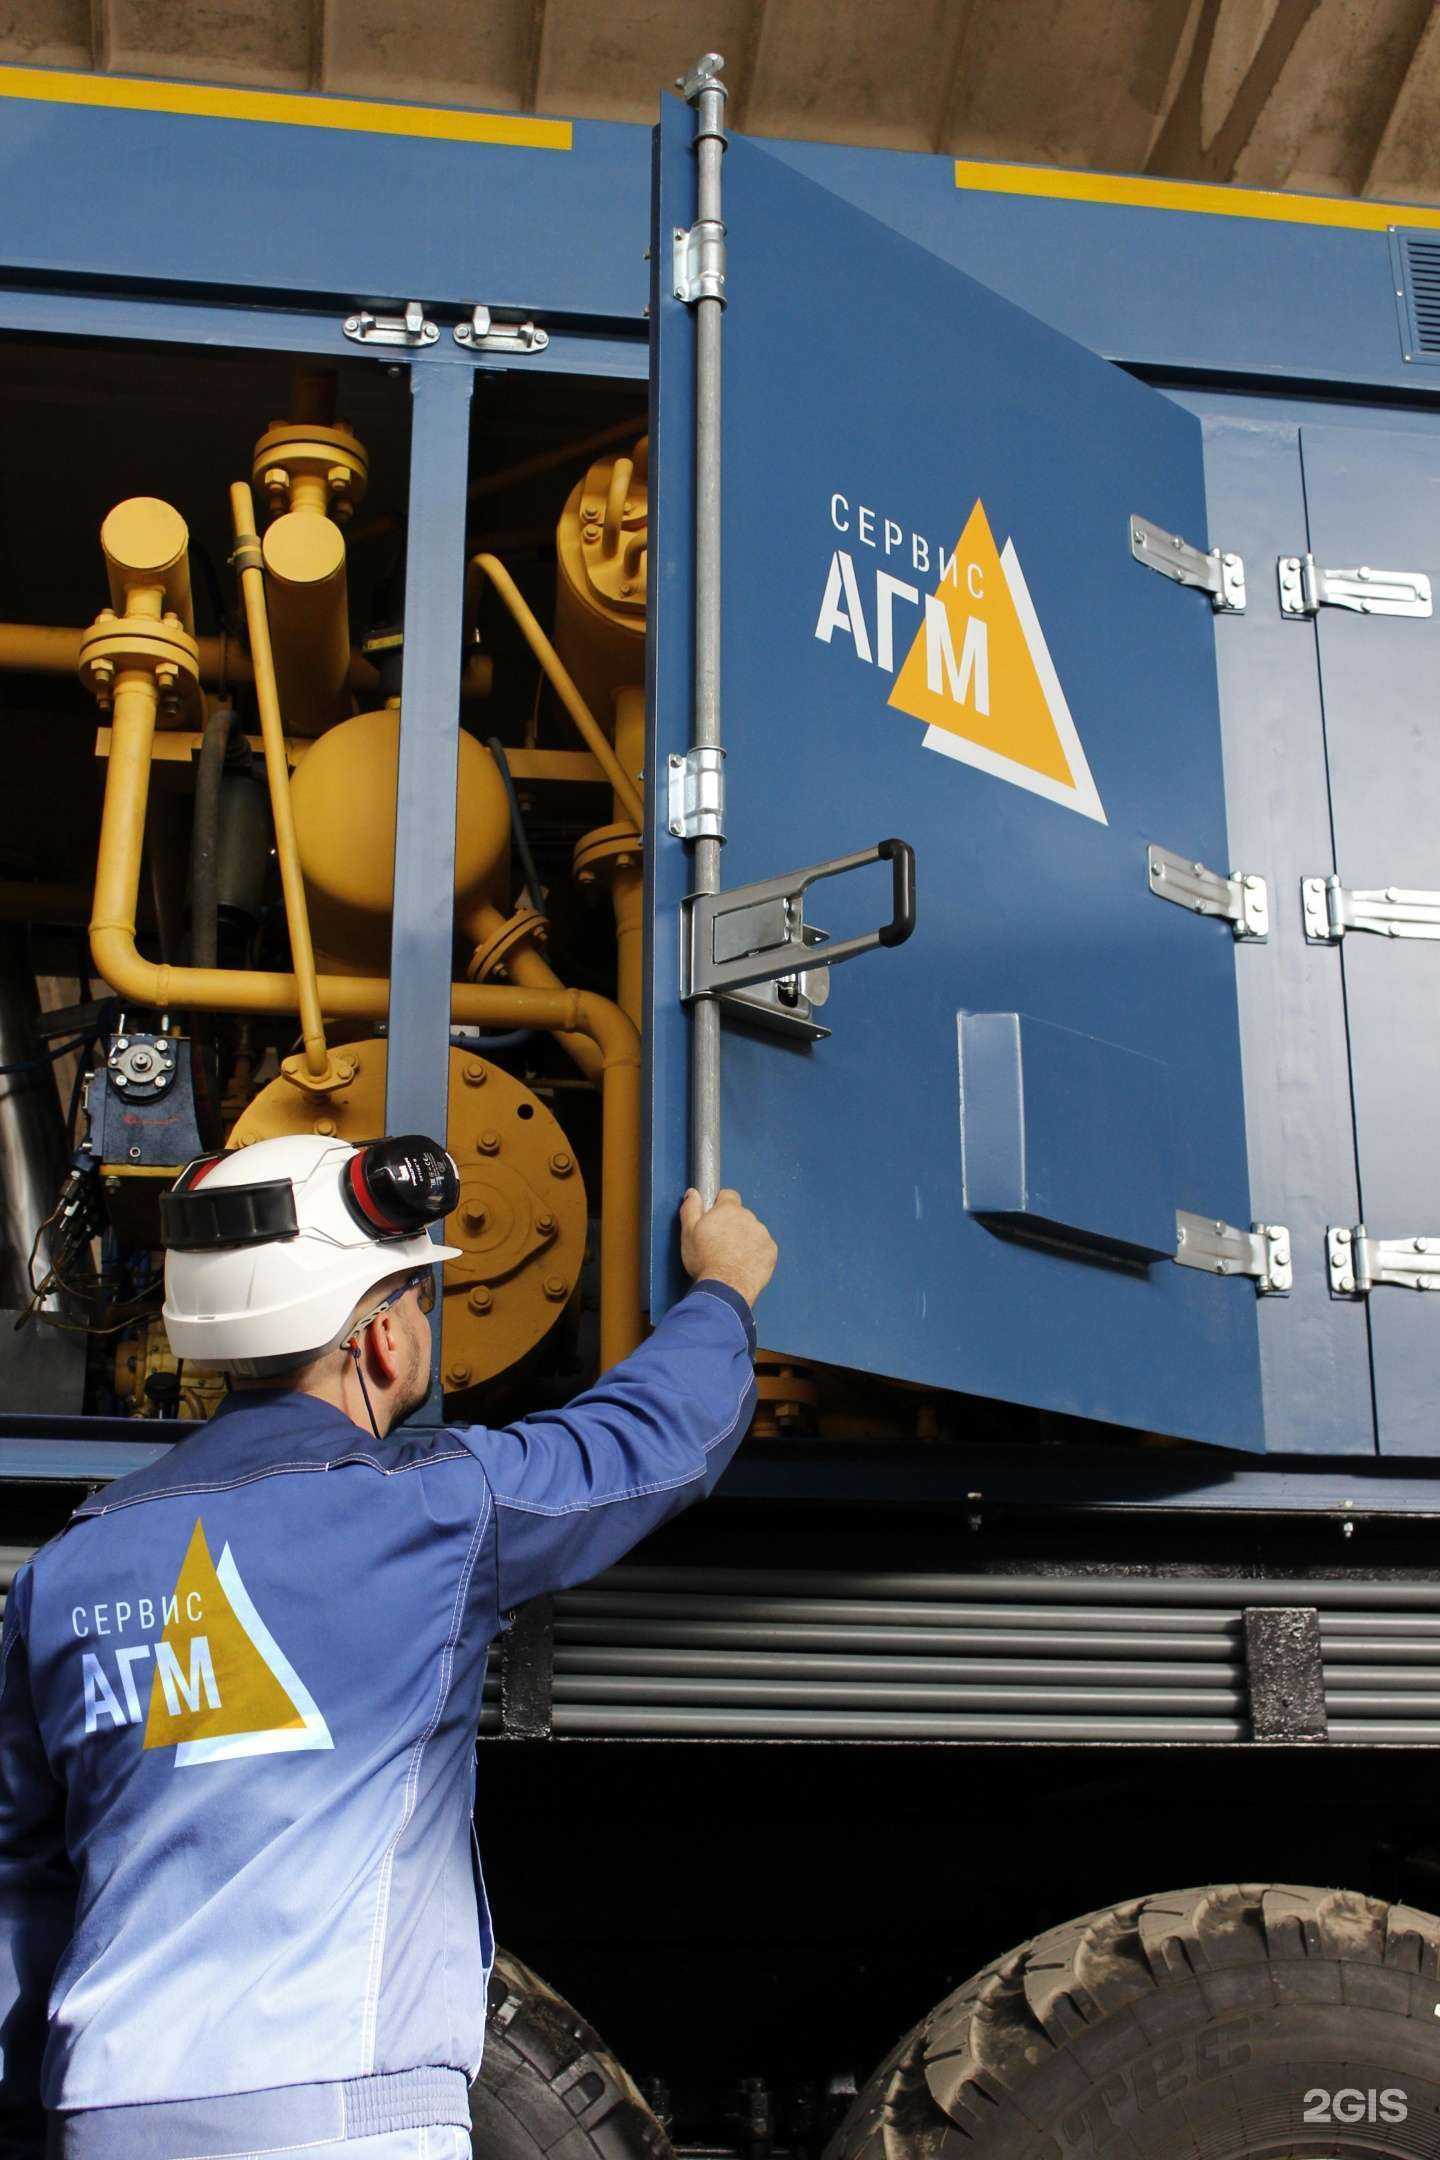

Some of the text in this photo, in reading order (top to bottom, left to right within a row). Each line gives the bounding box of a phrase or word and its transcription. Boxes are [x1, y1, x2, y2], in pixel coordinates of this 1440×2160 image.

[831, 493, 985, 600] СЕРВИС
[814, 550, 990, 717] АГМ
[72, 1591, 203, 1637] СЕРВИС
[81, 1635, 222, 1734] АГМ
